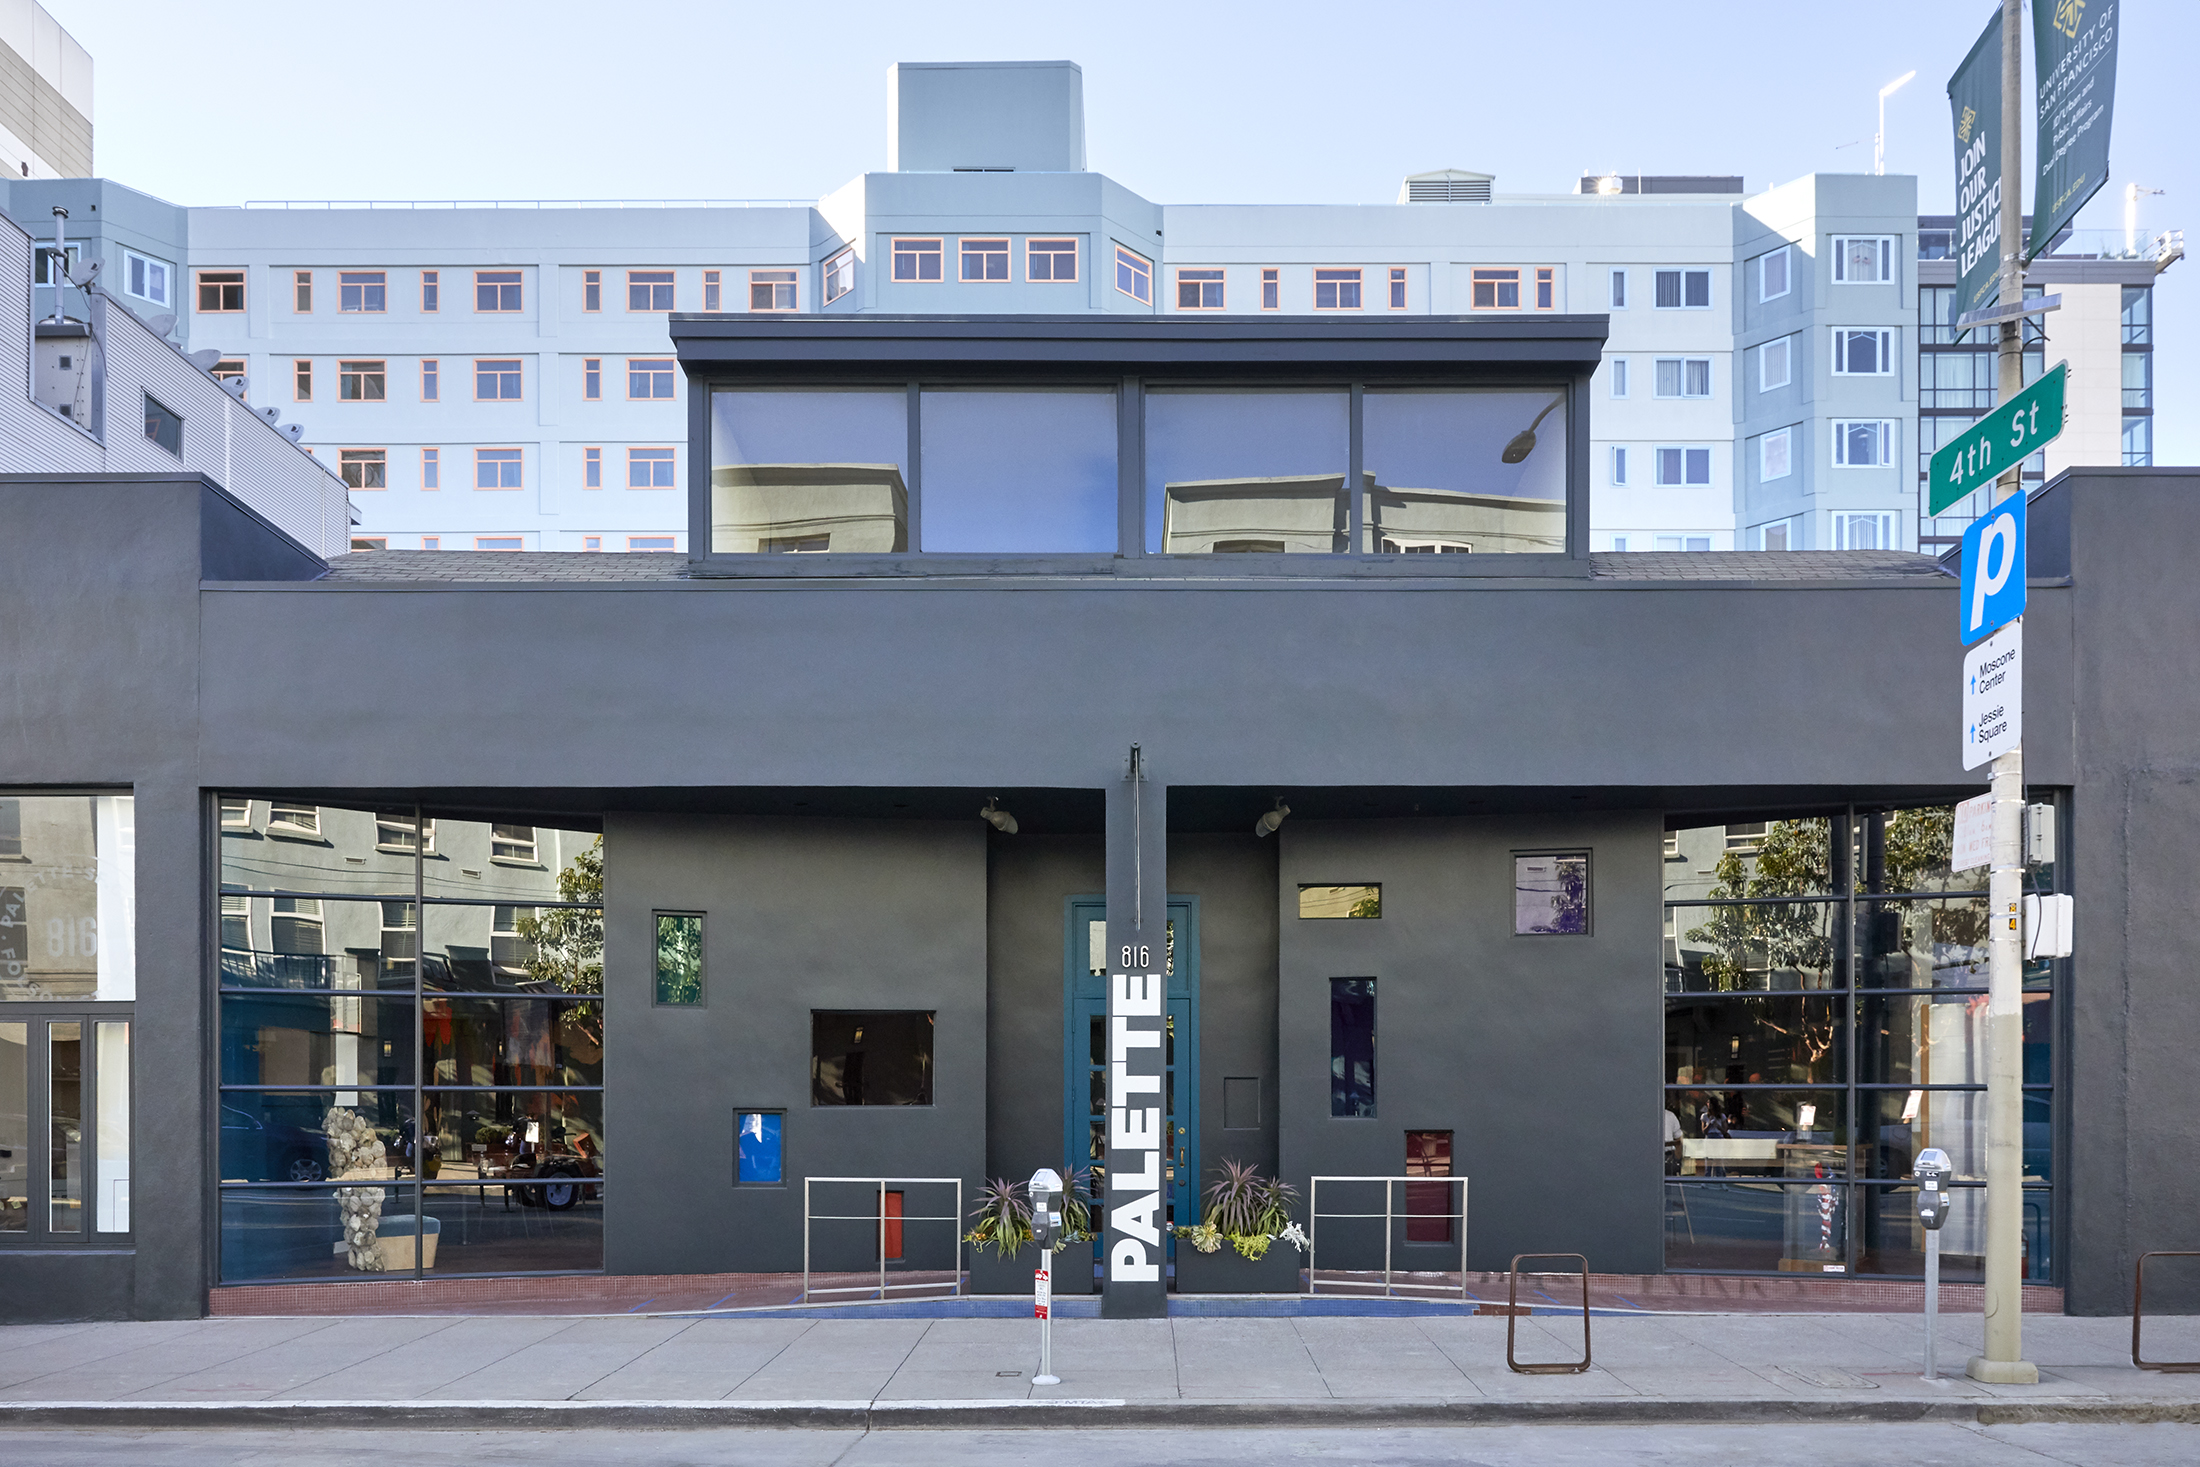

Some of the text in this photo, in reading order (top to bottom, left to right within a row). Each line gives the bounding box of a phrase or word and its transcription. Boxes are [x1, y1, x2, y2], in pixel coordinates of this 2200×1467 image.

[2040, 4, 2113, 99] UNIVERSITY OF
[2040, 27, 2113, 120] SAN FRANCISCO
[2082, 75, 2095, 97] and
[2042, 104, 2104, 176] Dual Degree Program
[2053, 99, 2093, 146] Public Affairs
[1960, 131, 1986, 185] JOIN
[1960, 166, 1987, 214] OUR
[1960, 176, 2001, 248] JUSTIC
[1961, 210, 2001, 279] LEAGU
[1949, 400, 2039, 485] 4th St
[1979, 648, 2016, 678] Moscone
[1979, 670, 2006, 694] Center
[1978, 704, 2005, 727] Jessie
[1978, 721, 2008, 743] Square
[1969, 801, 1991, 818] PARKIN
[47, 917, 98, 958] 816
[1121, 946, 1150, 968] 816
[1111, 974, 1161, 1282] PALETTE
